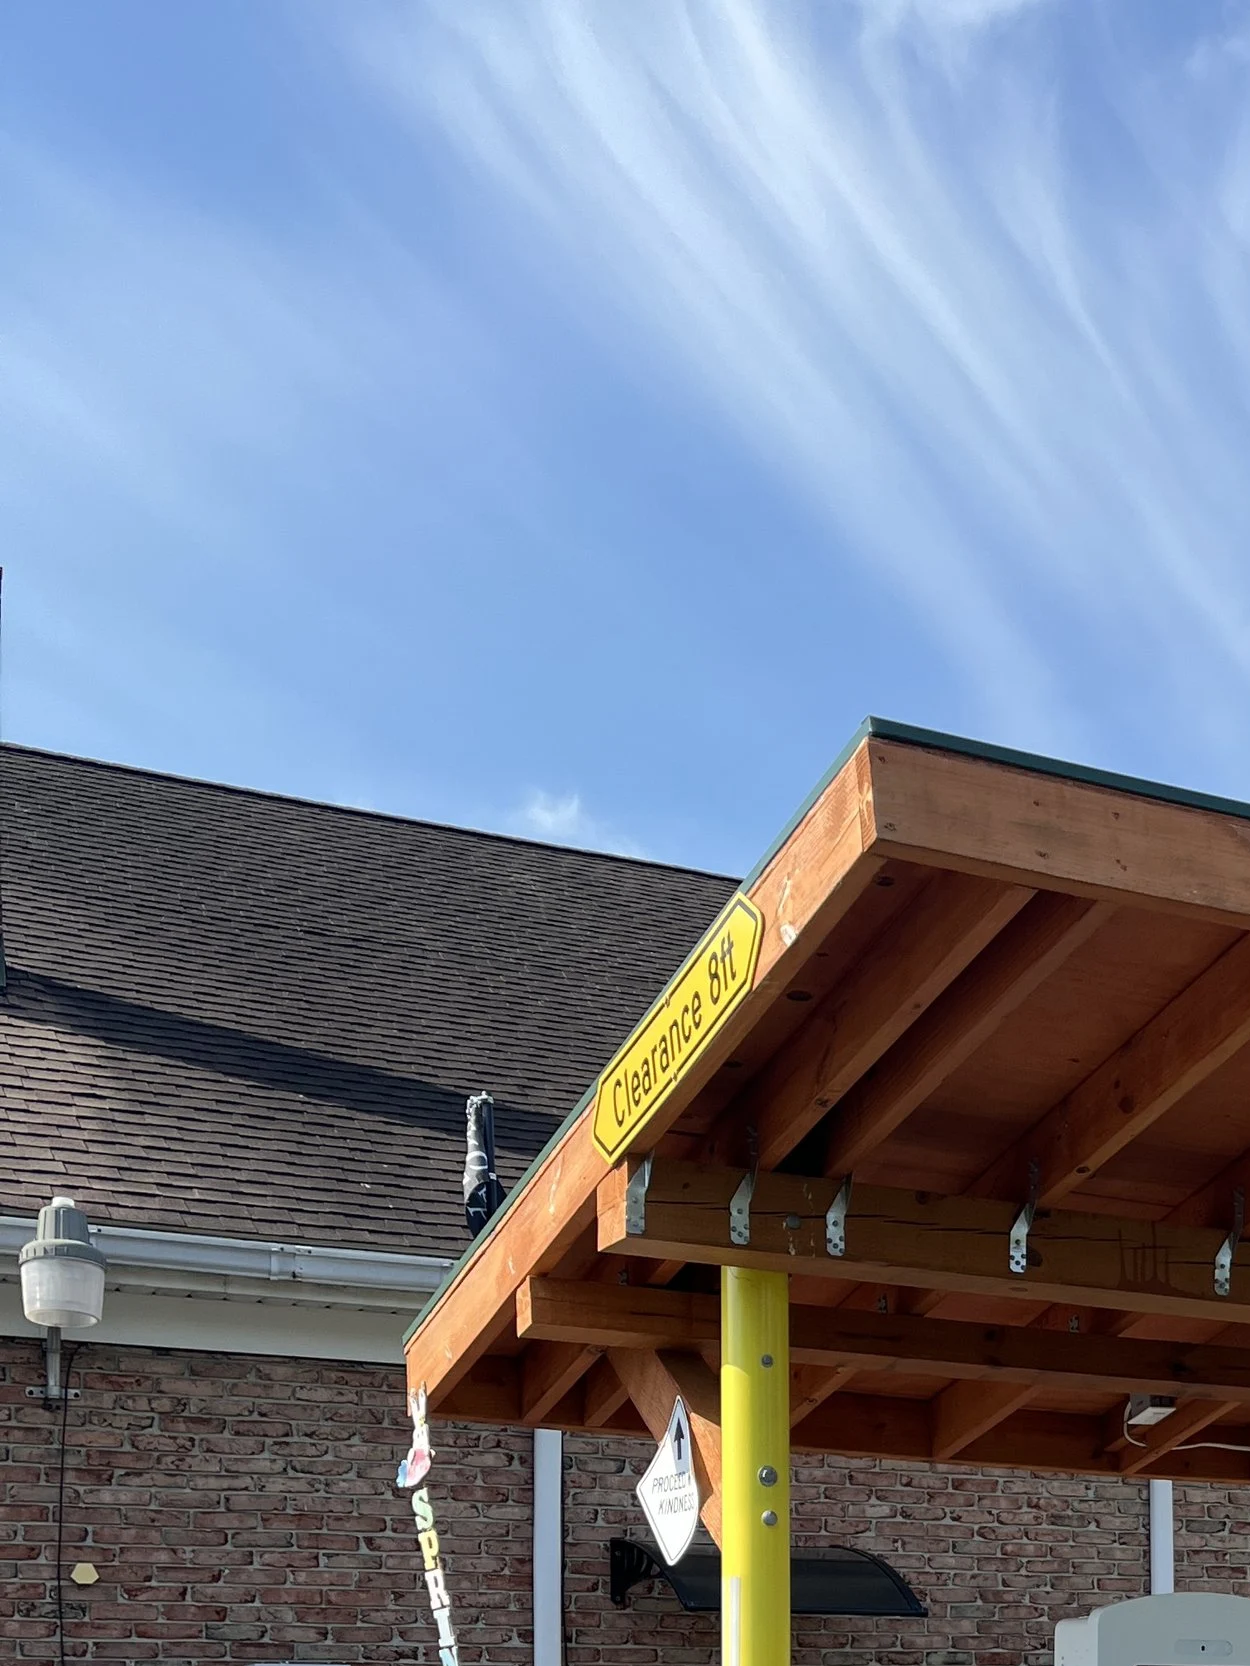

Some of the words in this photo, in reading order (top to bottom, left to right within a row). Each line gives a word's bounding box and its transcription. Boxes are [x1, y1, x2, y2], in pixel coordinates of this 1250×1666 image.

[613, 990, 702, 1128] Clearance
[708, 930, 737, 1006] 8ft
[652, 1471, 686, 1495] PROCEED
[658, 1492, 694, 1515] KINDNESS
